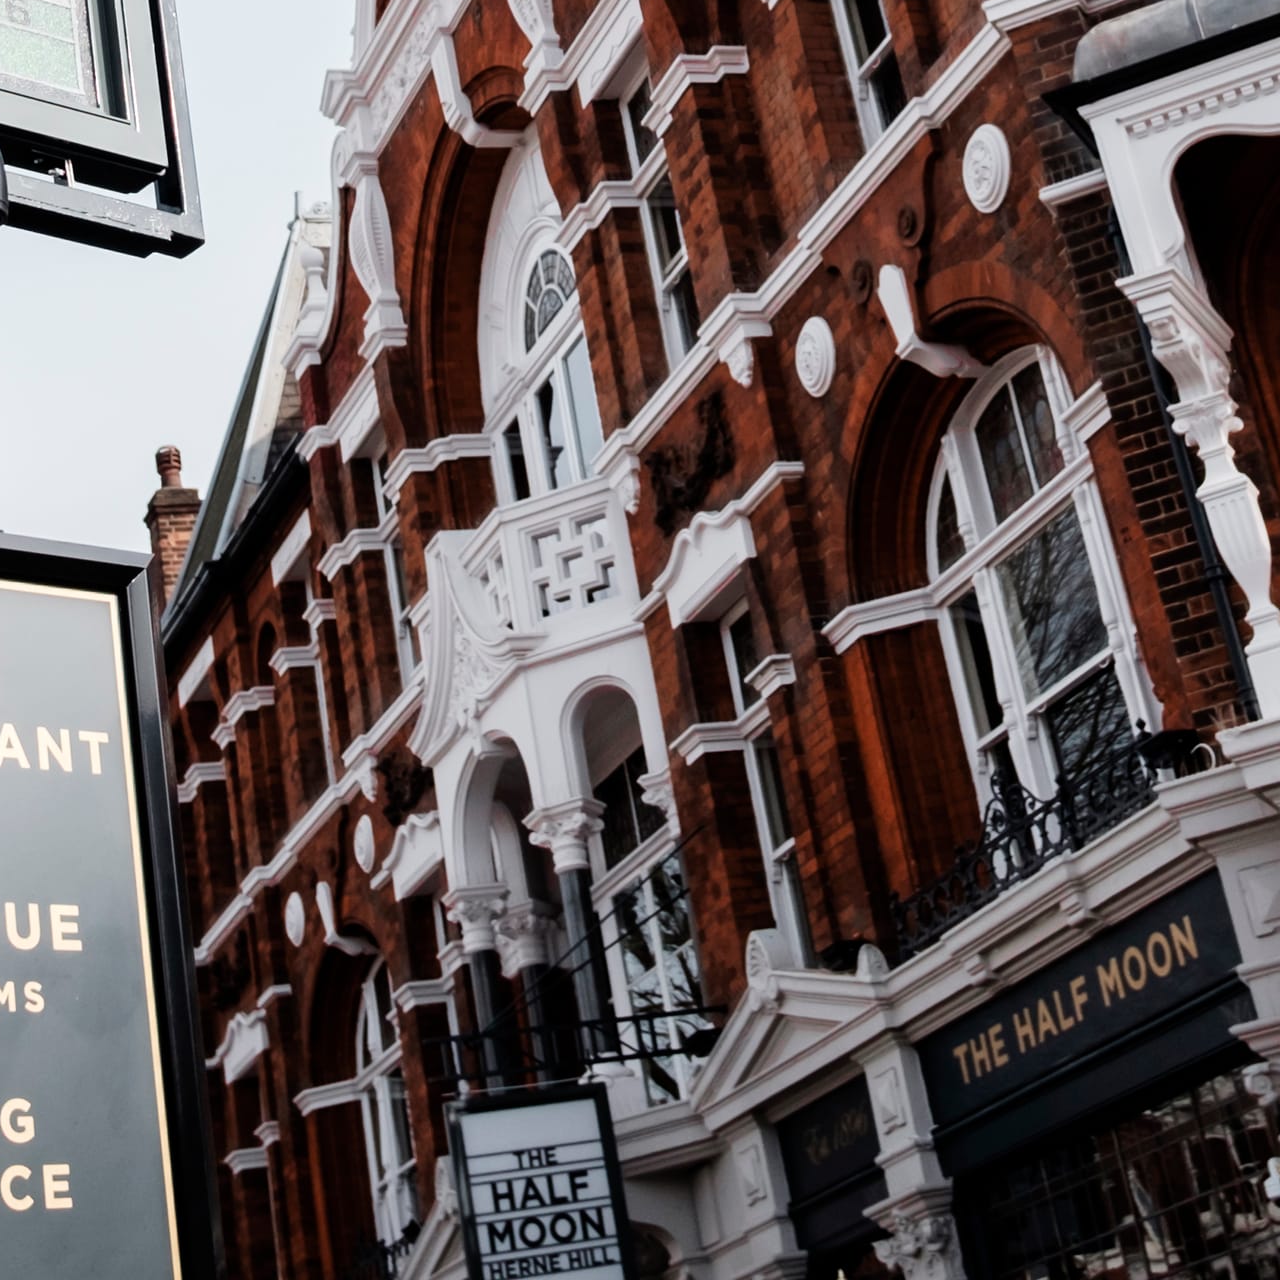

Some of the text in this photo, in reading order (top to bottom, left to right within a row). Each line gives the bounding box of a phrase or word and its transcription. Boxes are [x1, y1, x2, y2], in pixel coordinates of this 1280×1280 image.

[952, 915, 1200, 1085] THE HALF MOON
[512, 1146, 558, 1169] THE
[490, 1169, 589, 1213] HALF
[487, 1207, 606, 1254] MOON
[488, 1246, 616, 1280] HERNE HILL
